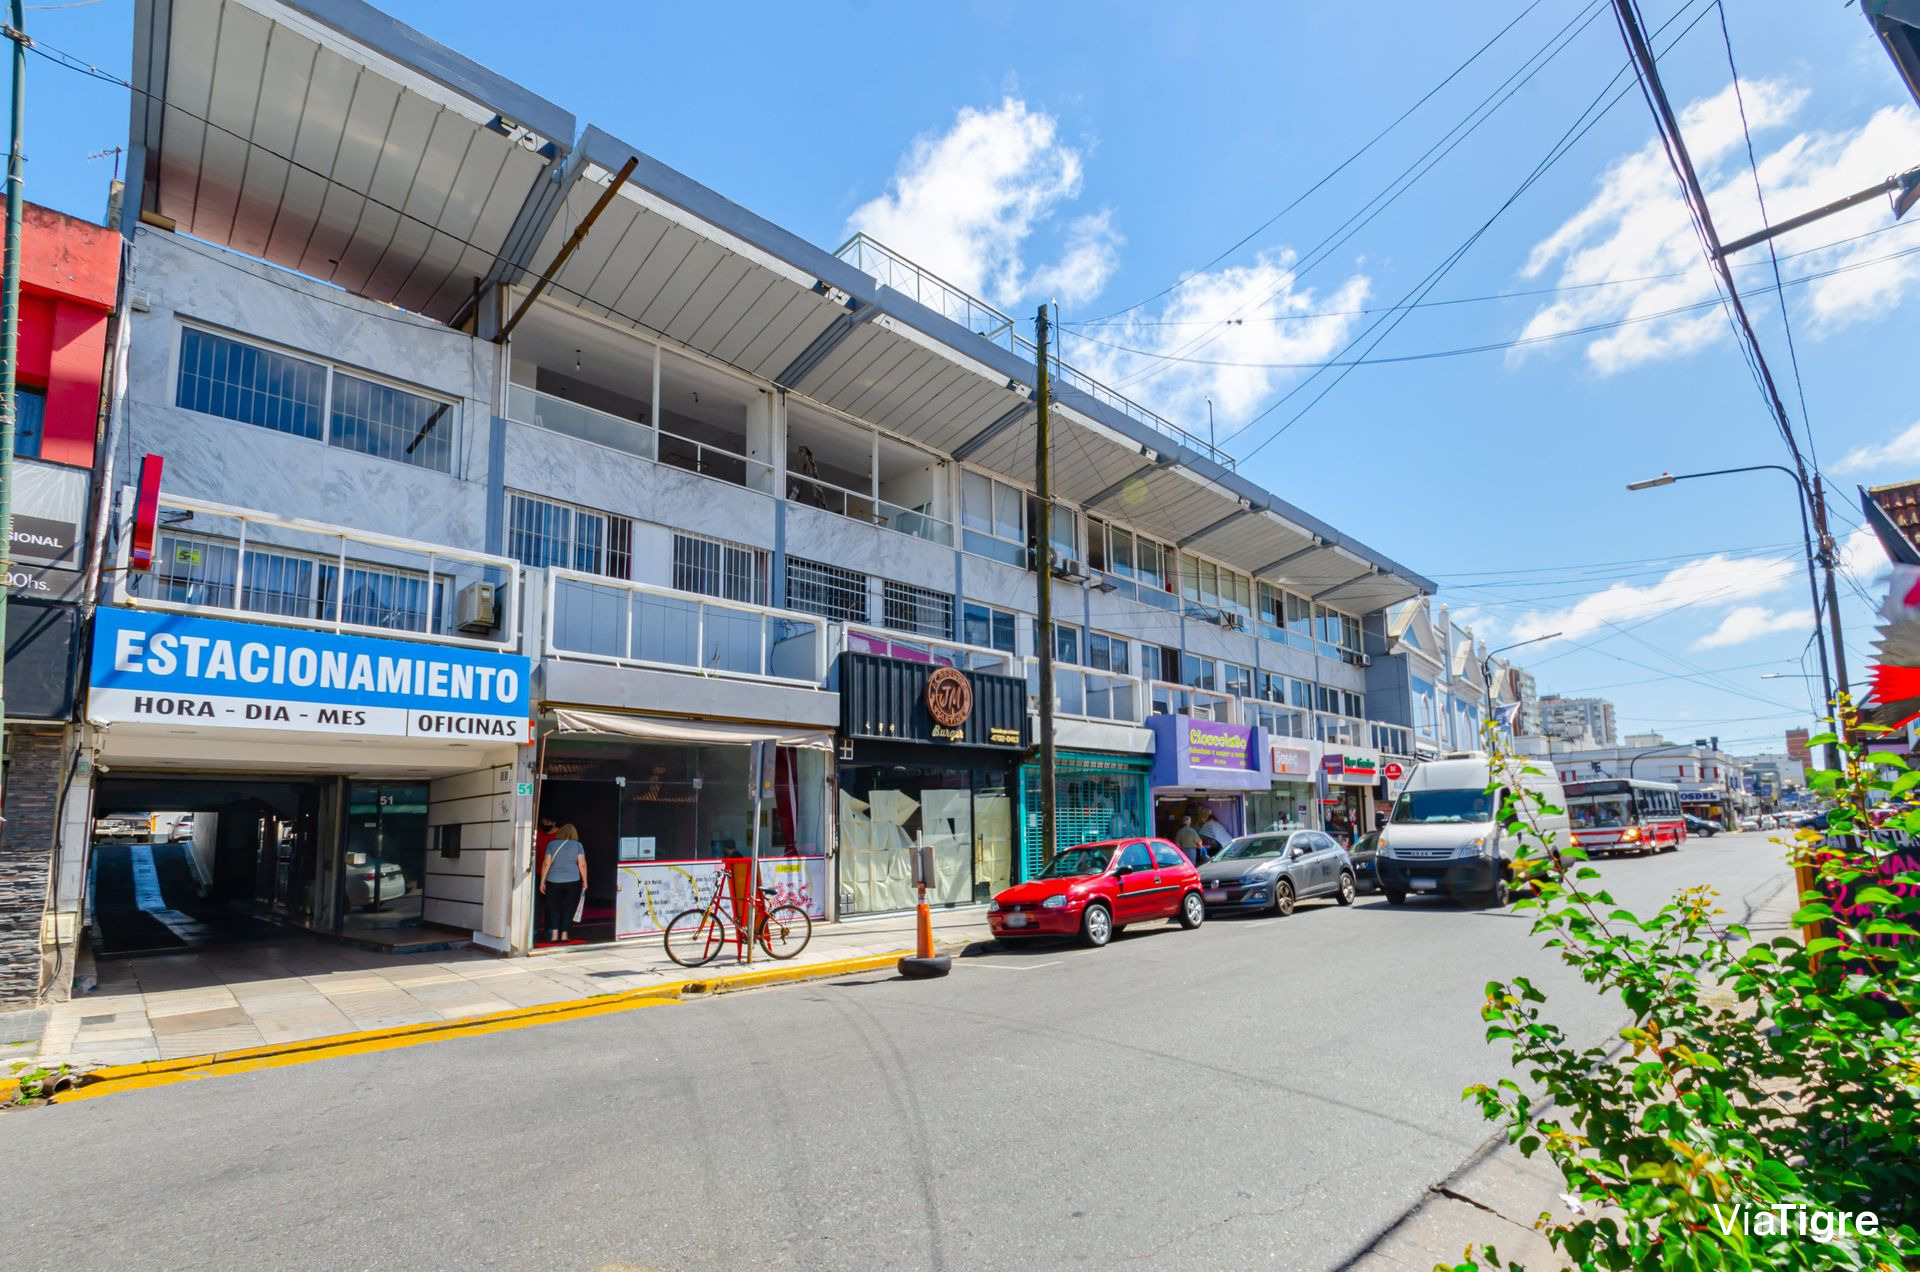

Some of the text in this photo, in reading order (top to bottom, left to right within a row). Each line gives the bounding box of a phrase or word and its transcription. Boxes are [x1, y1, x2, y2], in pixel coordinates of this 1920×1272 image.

[114, 628, 518, 704] ESTACIONAMIENTO
[134, 696, 215, 718] HORA
[245, 704, 290, 722] DIA
[317, 708, 366, 726] MES
[418, 714, 517, 737] OFICINAS
[931, 725, 964, 741] Burger
[518, 783, 533, 795] 51
[380, 796, 394, 806] 51
